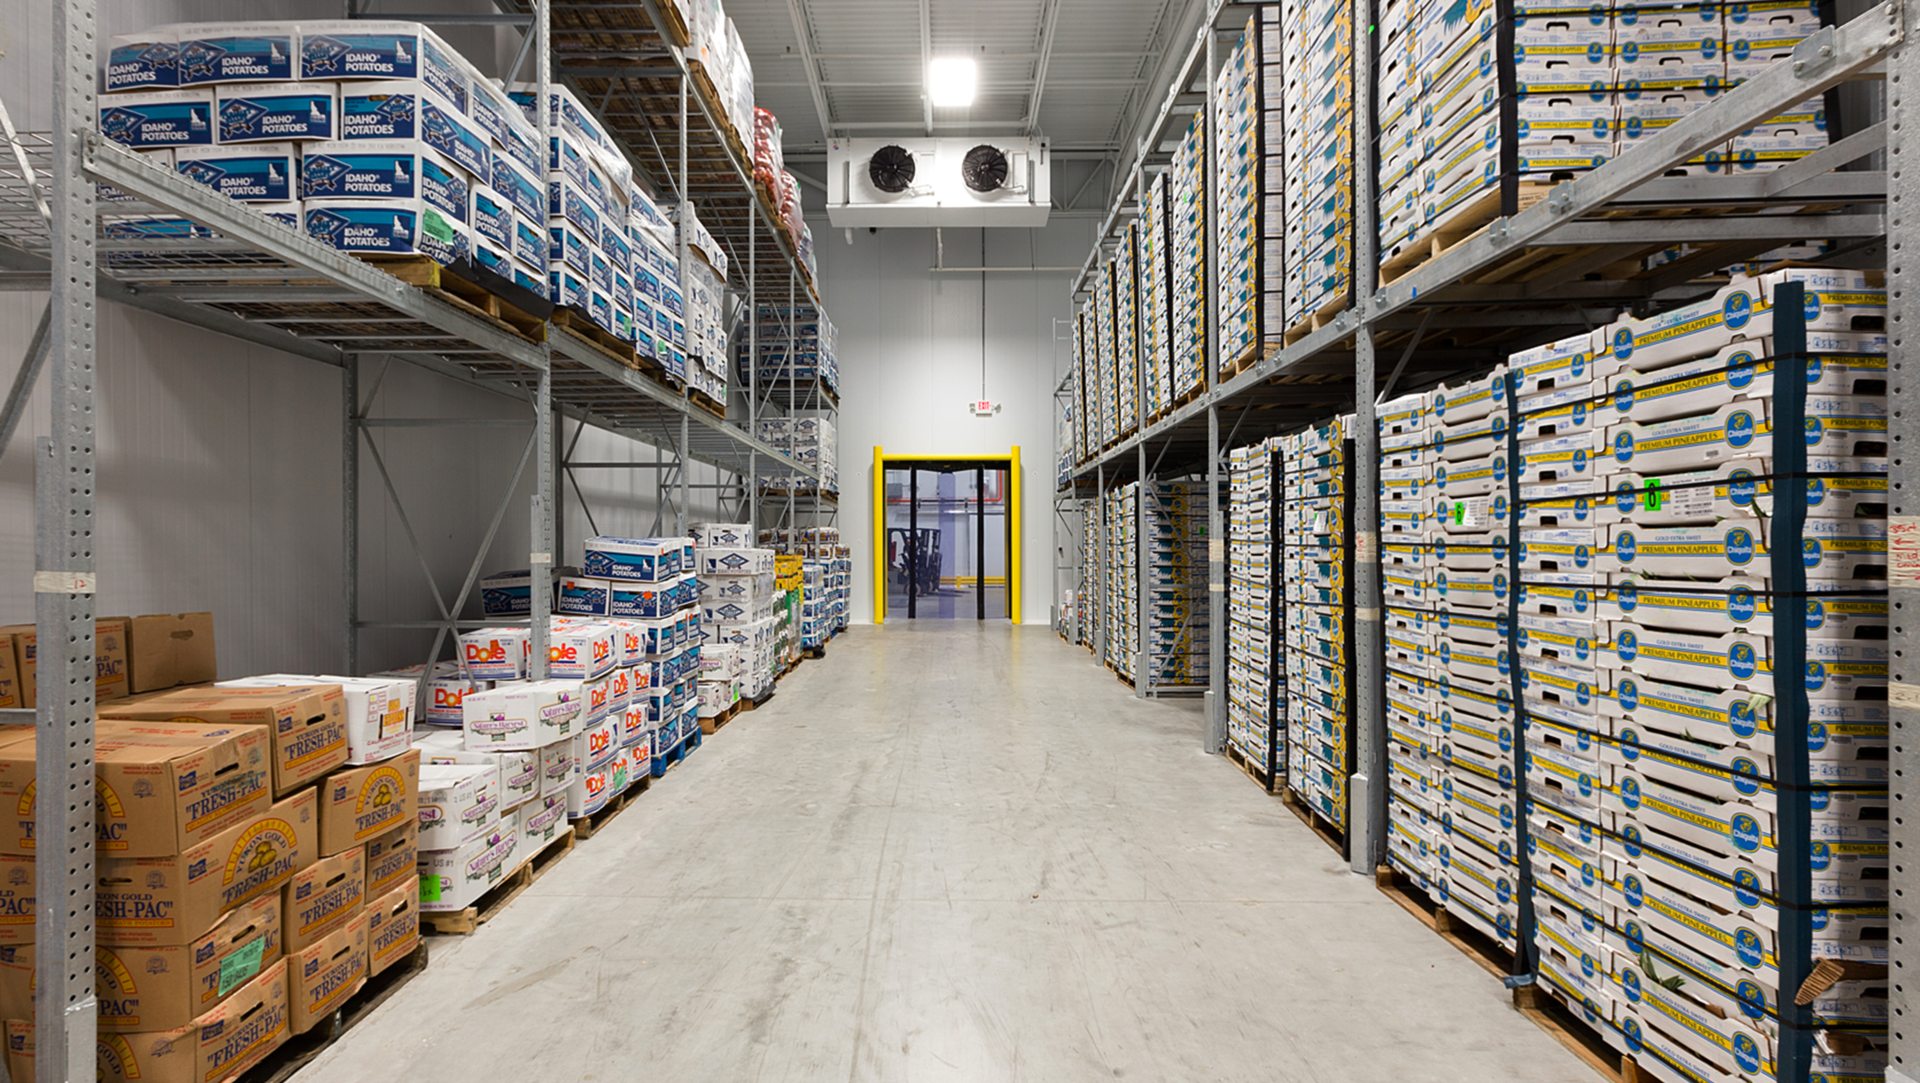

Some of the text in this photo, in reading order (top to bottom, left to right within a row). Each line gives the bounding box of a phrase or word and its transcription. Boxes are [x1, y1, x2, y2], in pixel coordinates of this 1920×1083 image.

[222, 56, 252, 66] IDAHO
[346, 54, 377, 62] IDAHO
[222, 66, 269, 75] POTATOES
[346, 63, 394, 72] POTATOES
[262, 115, 294, 124] IDAHO
[345, 115, 378, 124] IDAHO
[142, 123, 173, 132] IDAHO
[262, 124, 308, 134] POTATOES
[345, 125, 394, 135] POTATOES
[142, 131, 190, 141] POTATOES
[220, 178, 252, 186] IDAHO
[345, 174, 376, 182] IDAHO
[220, 186, 267, 195] POTATOES
[345, 183, 392, 192] POTATOES
[344, 228, 375, 236] IDAHO
[344, 237, 390, 246] POTATOES
[1639, 330, 1672, 346] PREMIUM
[1673, 316, 1716, 338] PINEAPPLES
[1640, 374, 1719, 398] PREMIUM PINEAPPLES
[1640, 433, 1718, 450] PREMIUM PINEAPPLES
[1643, 597, 1720, 608] PREMIUM PINEAPPLES
[550, 643, 576, 662] ole
[594, 638, 608, 658] Dole
[1643, 649, 1720, 664] PREMIUM PINEAPPLES
[435, 688, 463, 707] Dol
[1644, 698, 1721, 720] PREMIUM PINEAPPLES
[626, 709, 642, 728] Dole
[590, 728, 610, 752] Dole
[1646, 799, 1723, 831] PREMIUM PINEAPPLES
[96, 901, 173, 918] ESH-PAC"
[1650, 900, 1728, 943] PREMIUM PINEAPPLES
[1648, 996, 1726, 1046] PREMIUM PINEAPPLES
